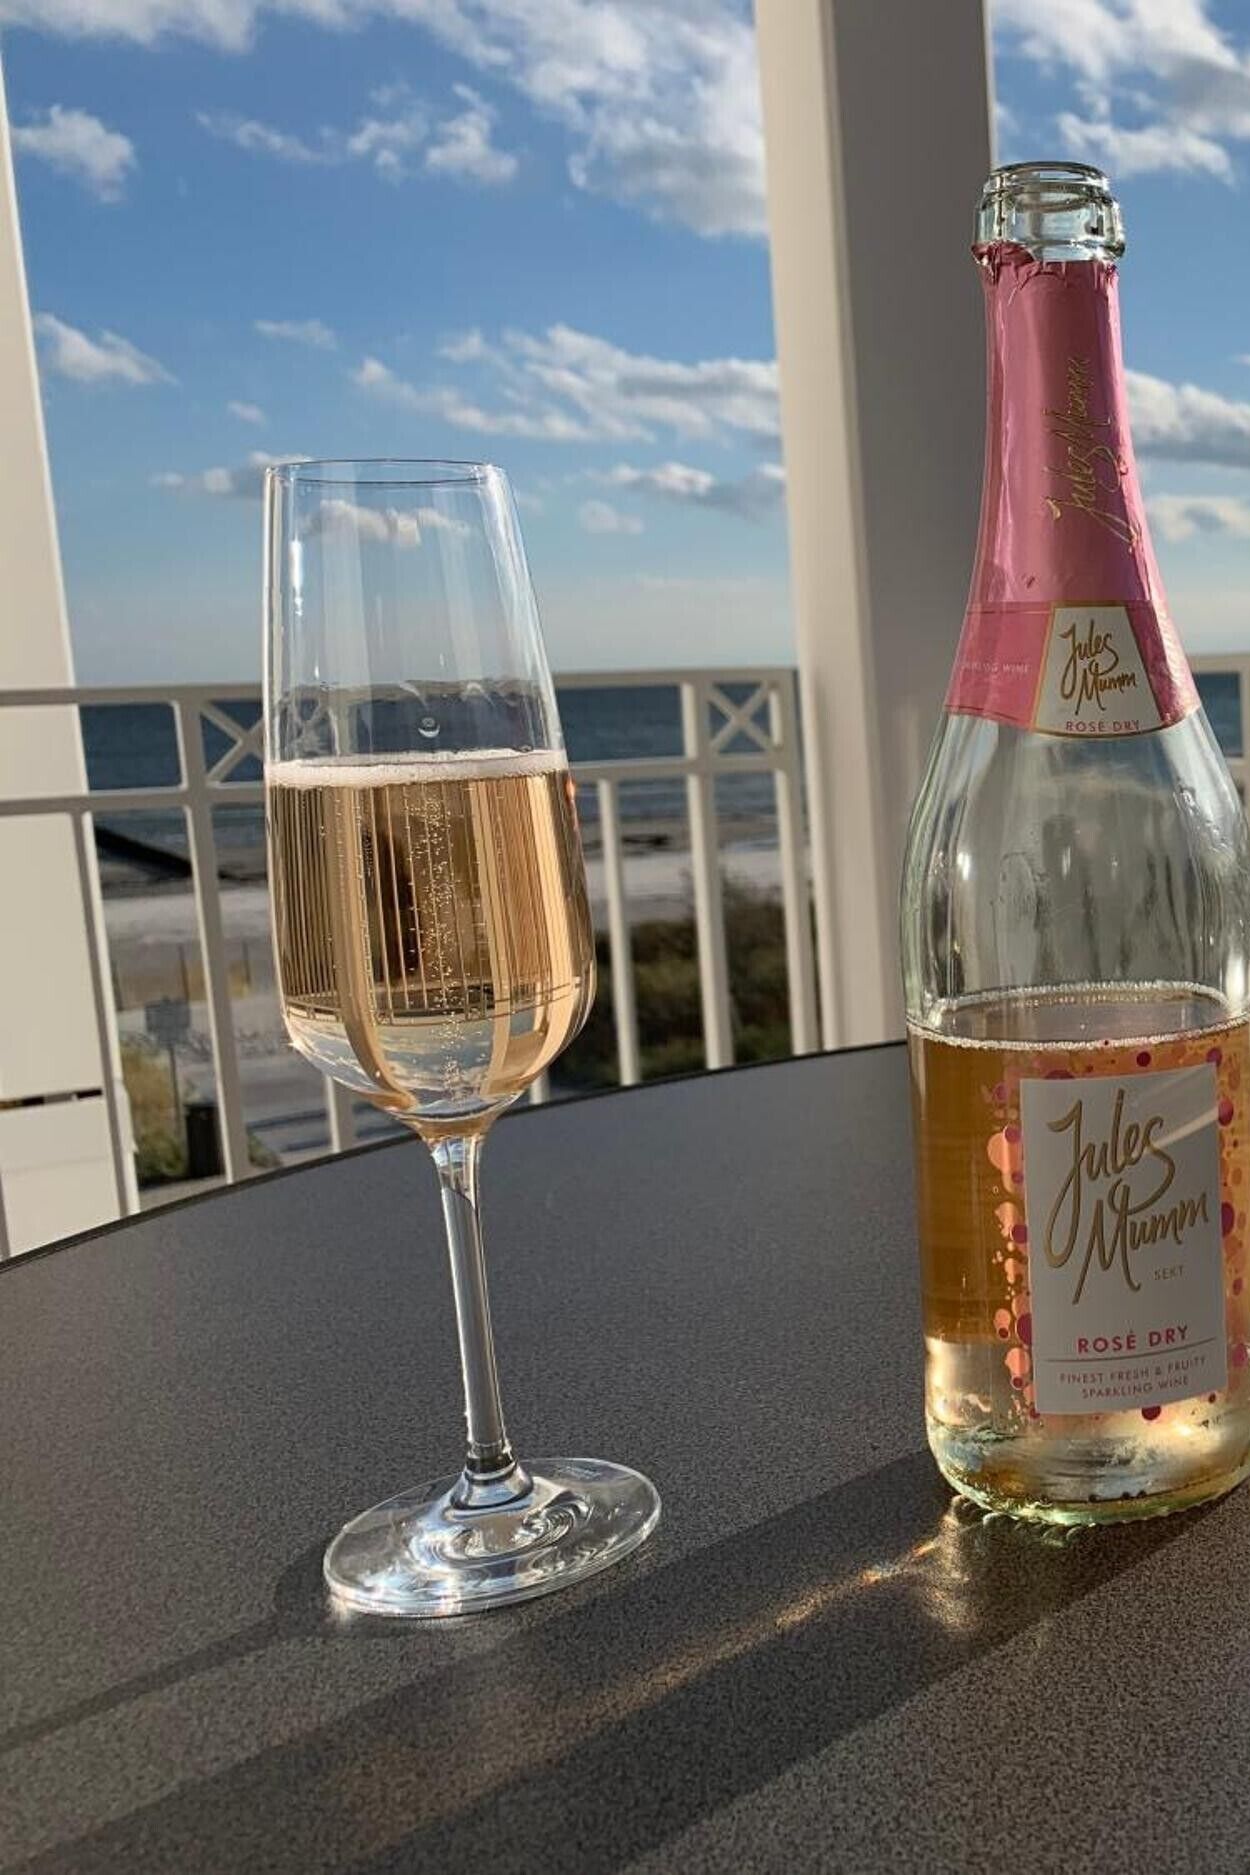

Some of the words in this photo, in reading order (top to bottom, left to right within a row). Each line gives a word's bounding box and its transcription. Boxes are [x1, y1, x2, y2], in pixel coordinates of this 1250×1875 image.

[1061, 620, 1119, 699] Jules
[1076, 661, 1137, 715] Mumm
[1112, 720, 1140, 732] DRY
[1046, 1089, 1176, 1268] Jules
[1072, 1186, 1209, 1304] Mumm
[1153, 1266, 1184, 1281] SEKT
[1077, 1329, 1137, 1354] ROSÉ
[1149, 1324, 1188, 1347] DRY
[1060, 1372, 1105, 1385] FINEST
[1110, 1367, 1149, 1382] FRESH
[1155, 1366, 1162, 1376] &
[1168, 1355, 1206, 1373] FRUITY
[1082, 1381, 1153, 1399] SPARKLING
[1158, 1375, 1189, 1389] WINE
